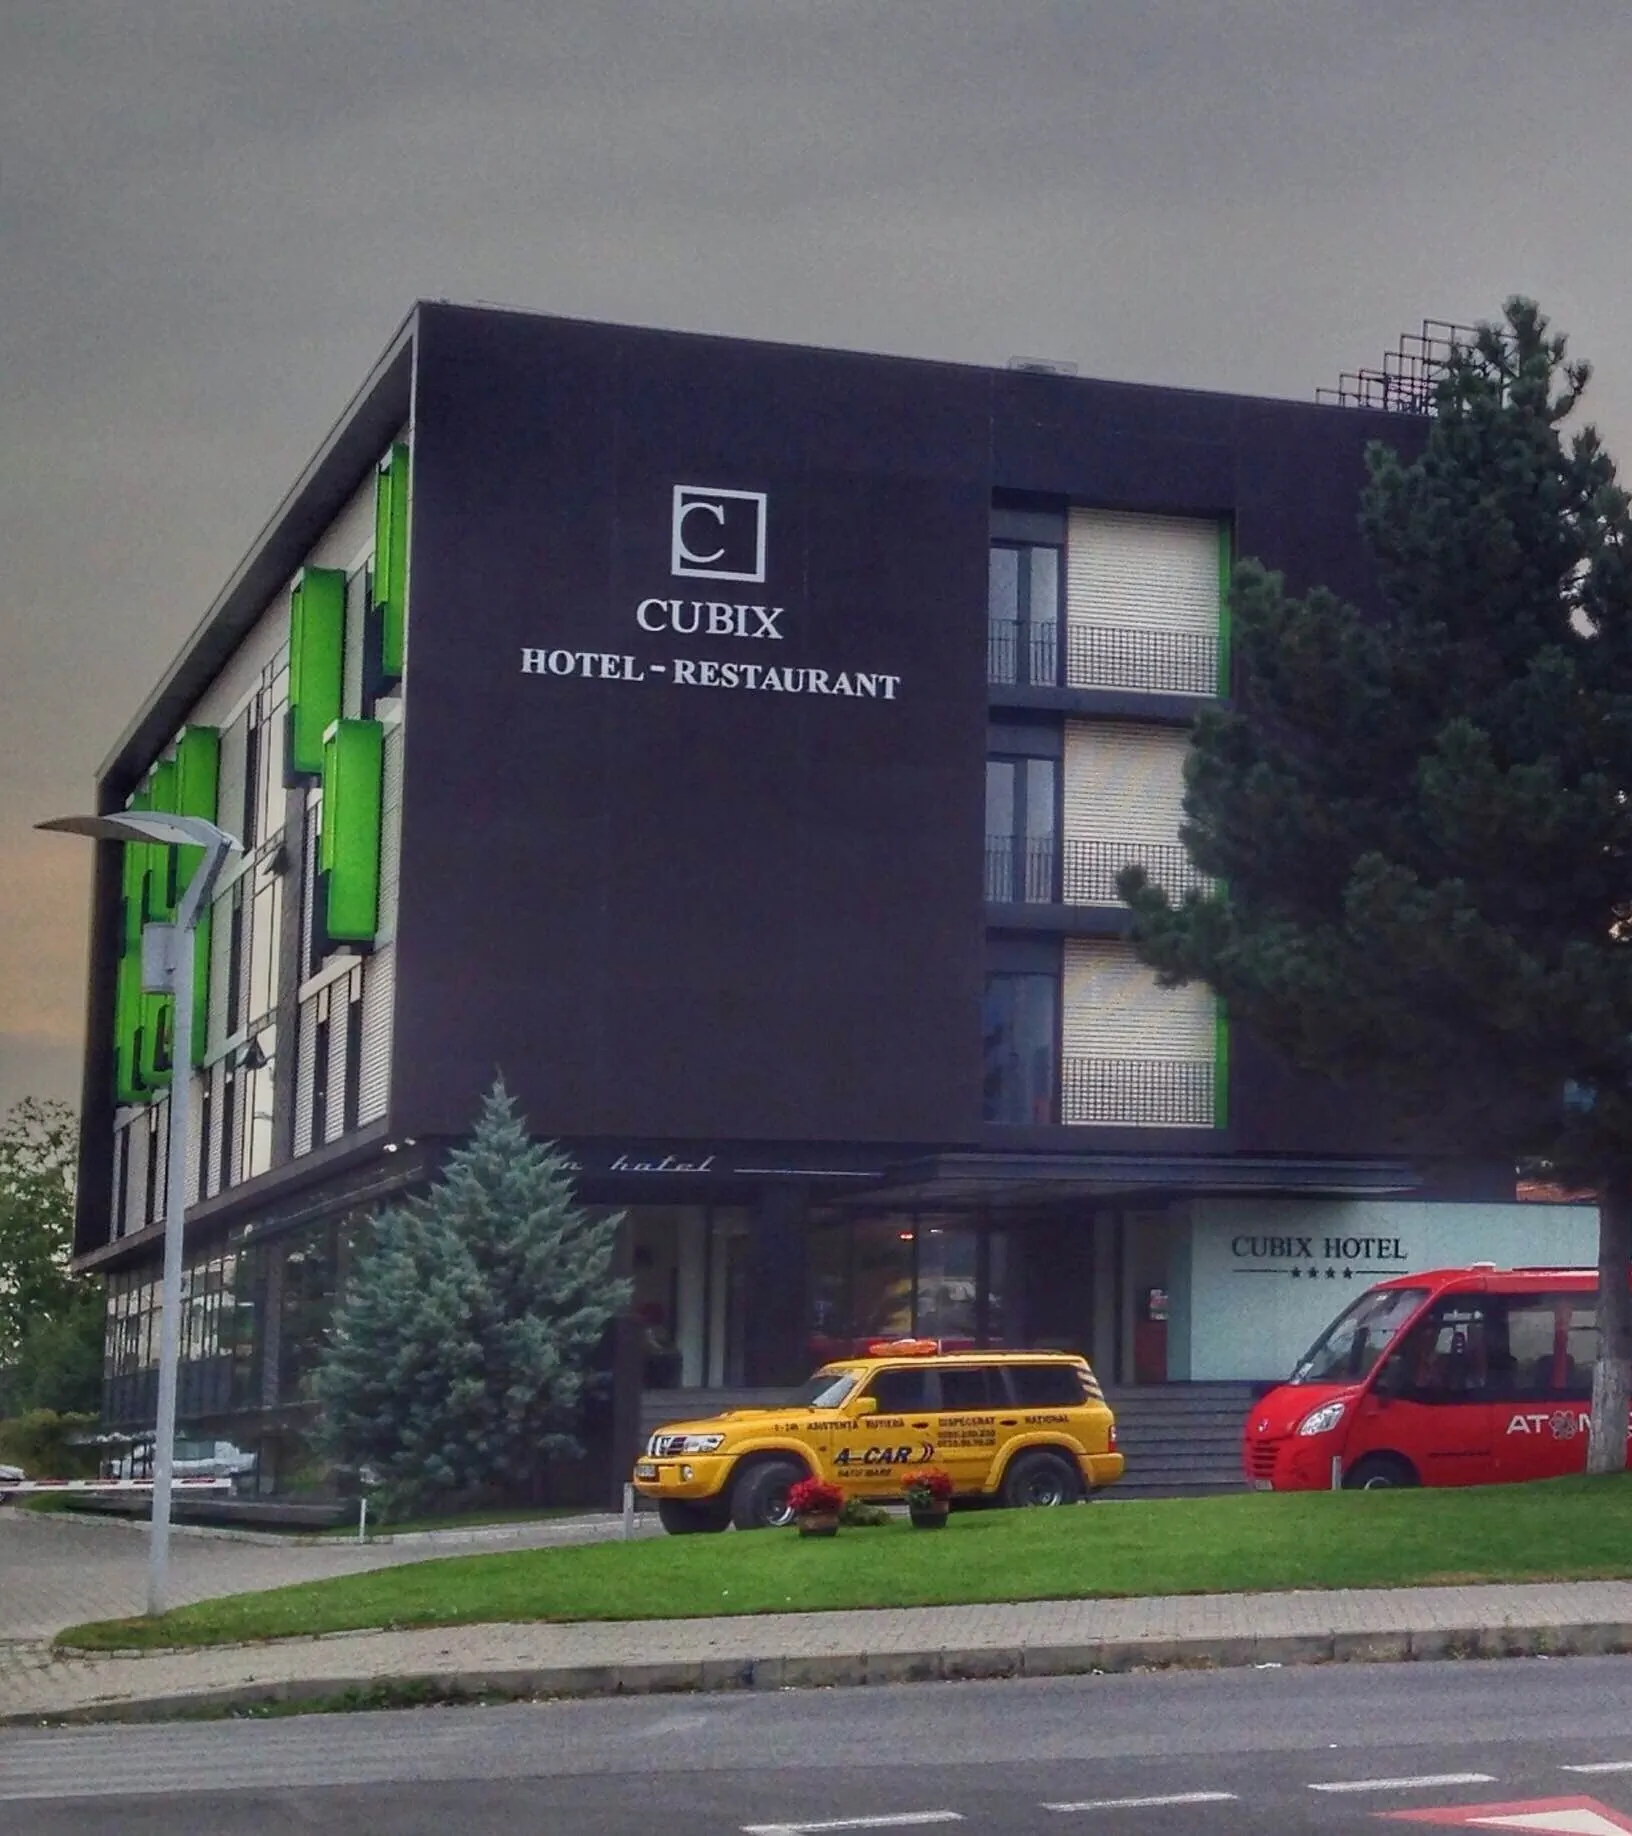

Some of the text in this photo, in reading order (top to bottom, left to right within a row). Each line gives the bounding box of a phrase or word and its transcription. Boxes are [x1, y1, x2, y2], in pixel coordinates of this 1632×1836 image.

[636, 598, 785, 640] CUBIX
[1231, 1236, 1408, 1260] CUBIX HOTEL
[834, 1446, 913, 1465] A-CAR
